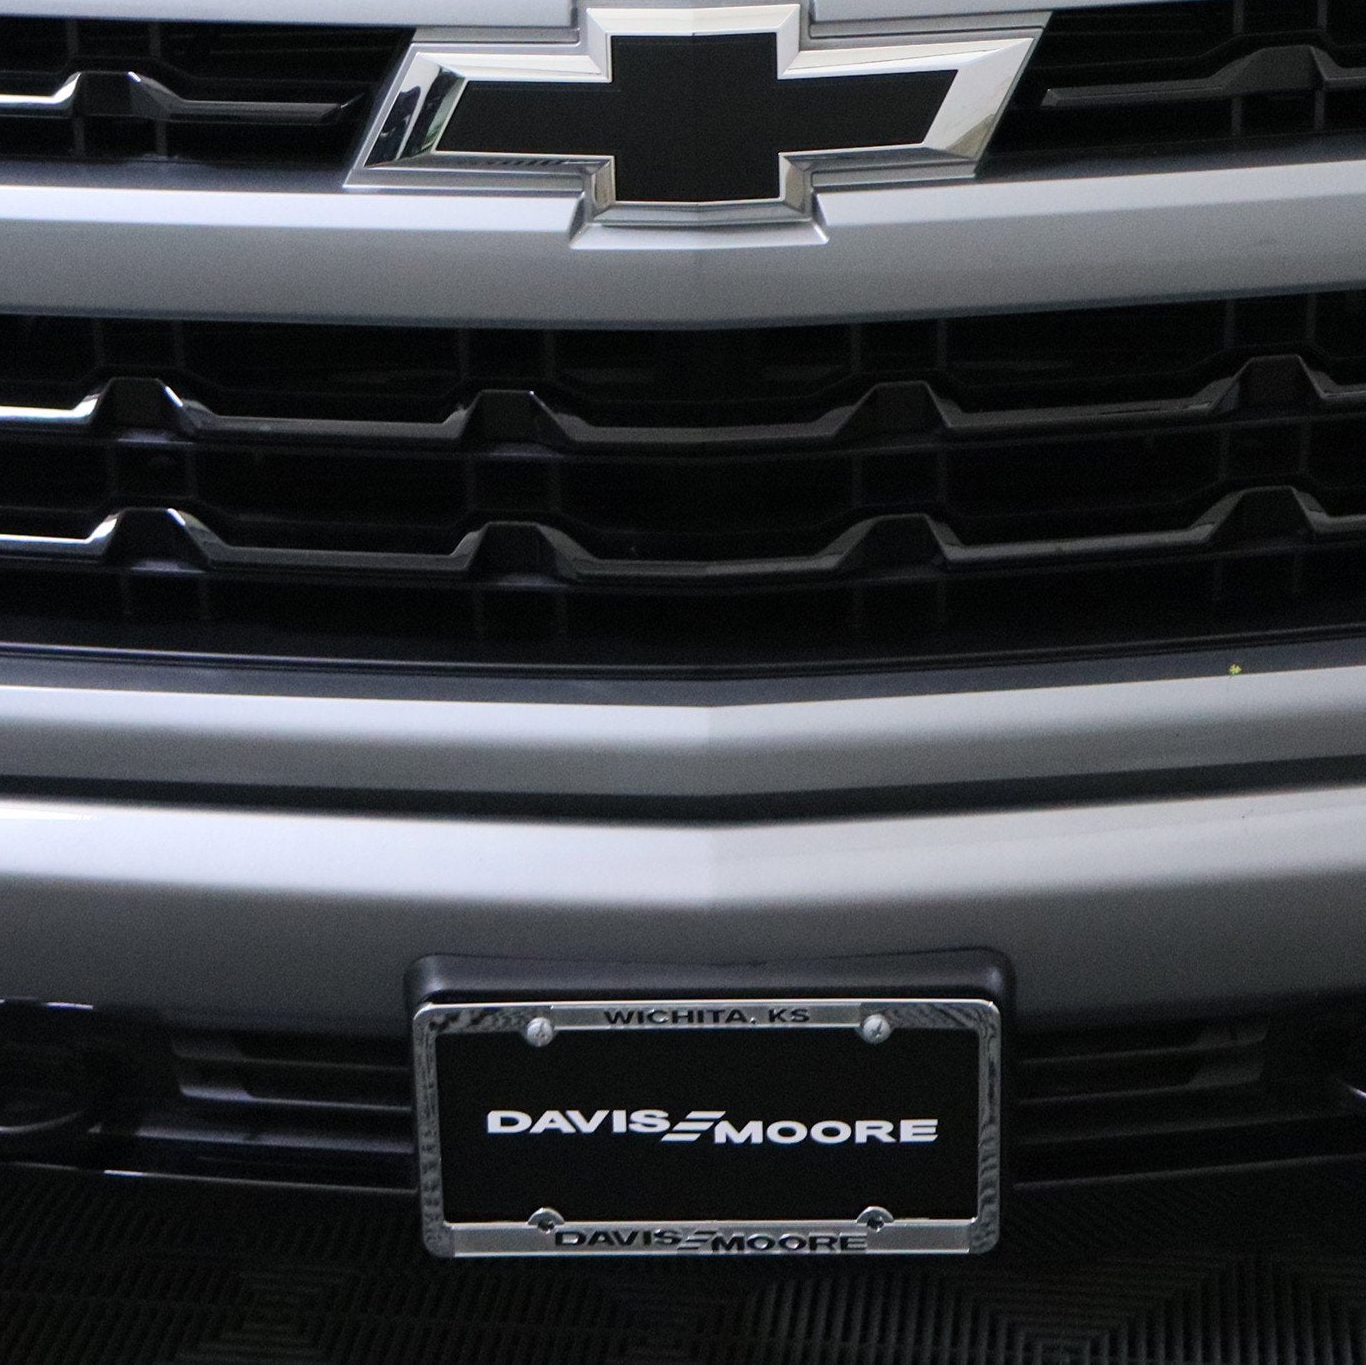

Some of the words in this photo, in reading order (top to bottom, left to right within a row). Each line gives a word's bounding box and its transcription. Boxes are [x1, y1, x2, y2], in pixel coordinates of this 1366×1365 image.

[768, 1008, 811, 1023] KS
[487, 1109, 672, 1134] DAVIS
[714, 1119, 939, 1145] MOORE
[554, 1229, 682, 1246] DAVIS
[710, 1232, 869, 1252] MOORE
